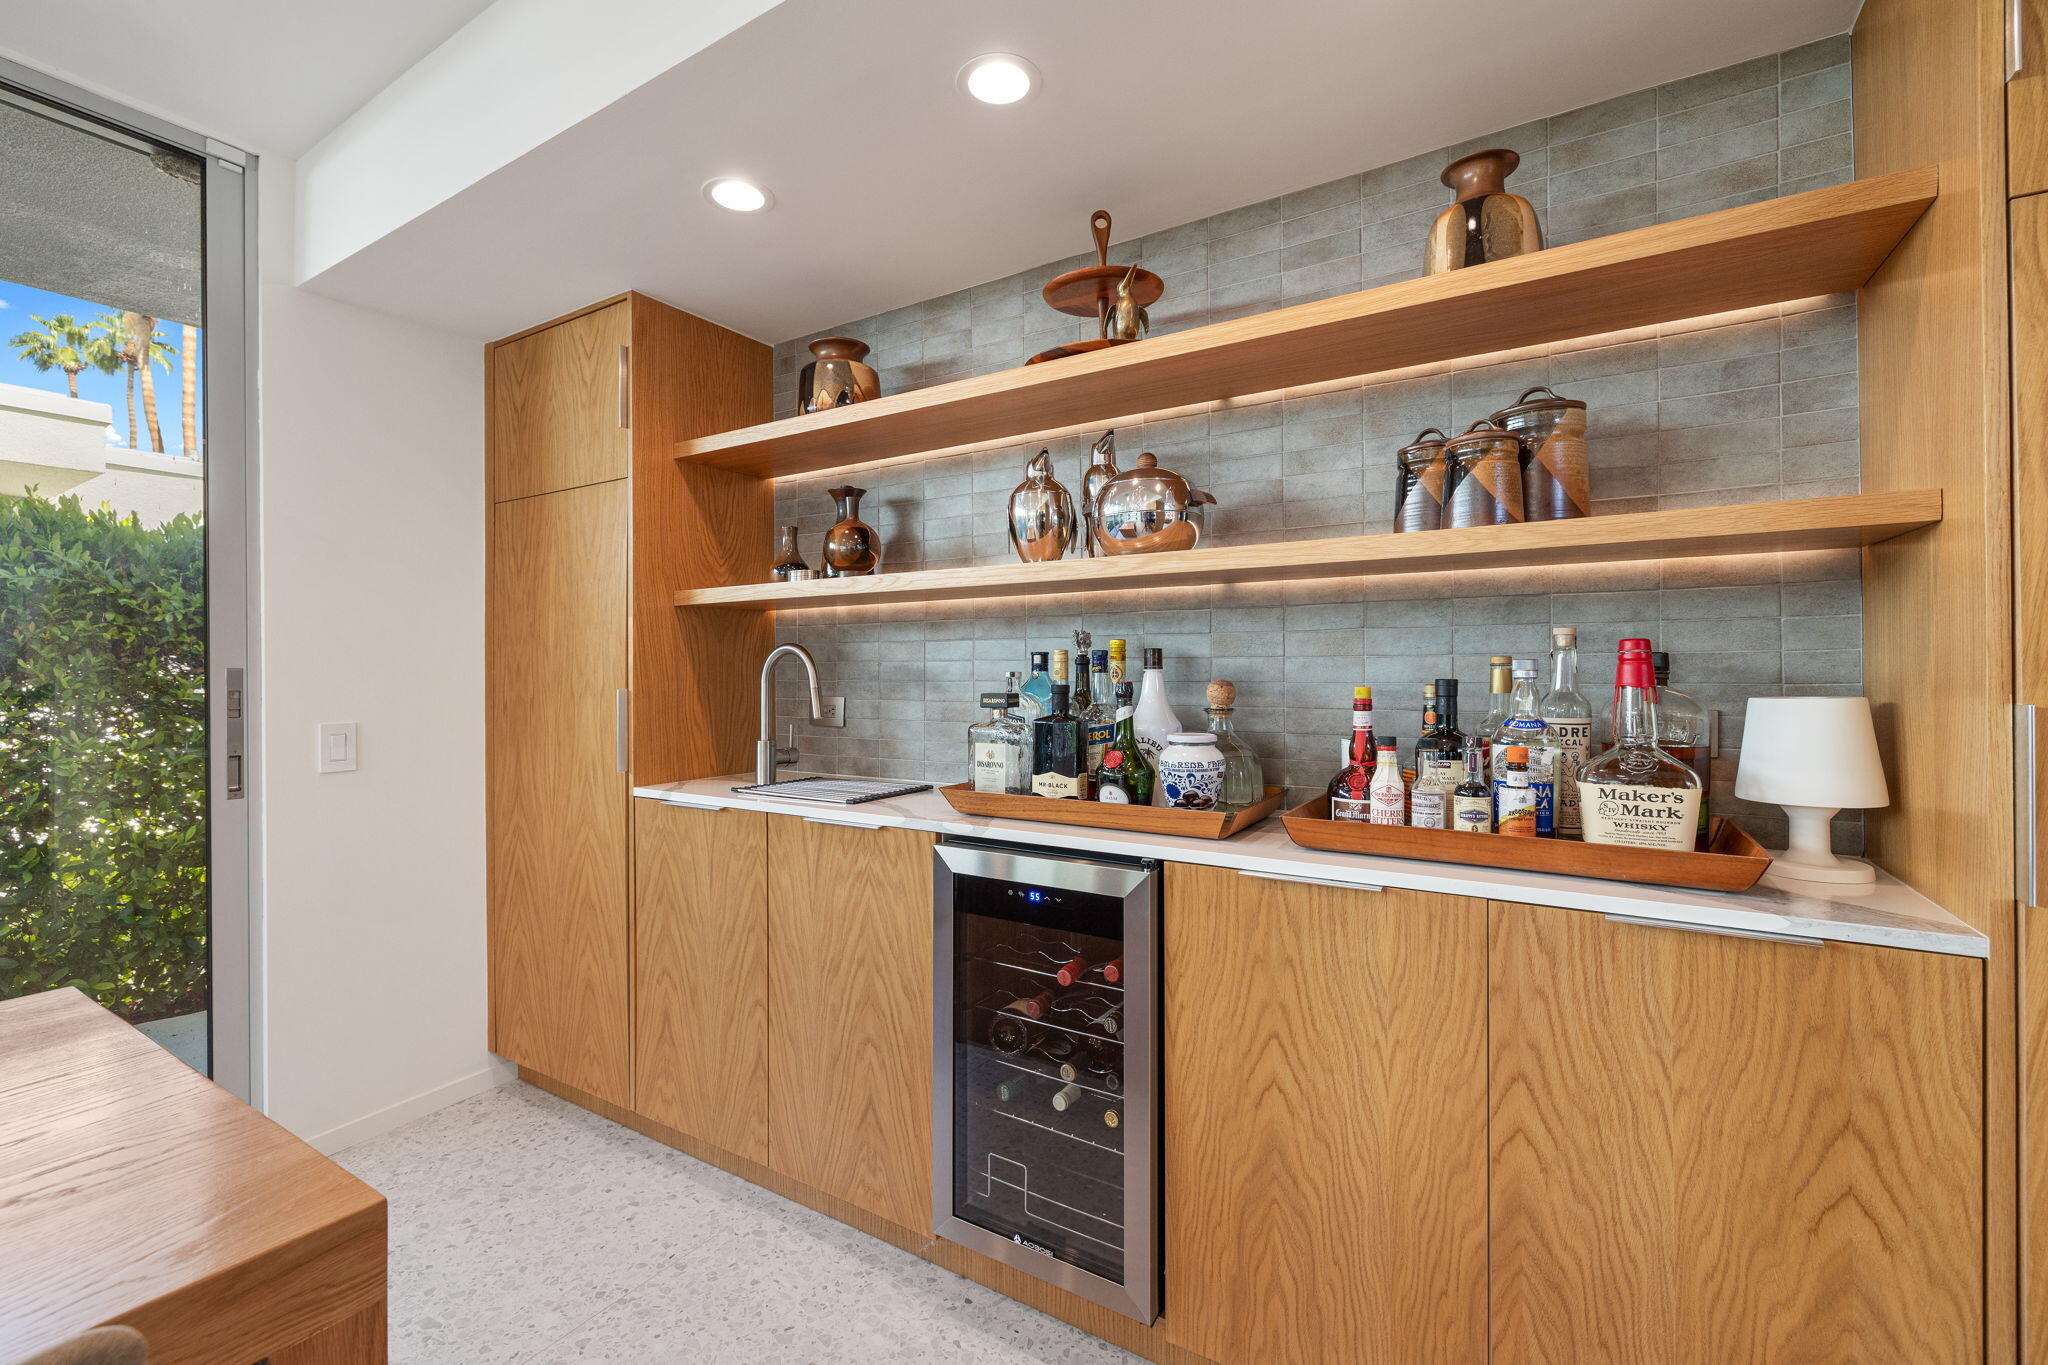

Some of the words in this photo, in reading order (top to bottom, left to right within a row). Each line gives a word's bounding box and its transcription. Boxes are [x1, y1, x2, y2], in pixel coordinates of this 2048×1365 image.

[1087, 729, 1111, 742] EROL
[1560, 727, 1589, 738] DRE
[1135, 736, 1163, 752] ALIBU
[976, 760, 1004, 769] DISARONNO
[1597, 787, 1684, 804] Maker's
[1371, 808, 1405, 818] CHERRY
[1620, 803, 1684, 820] Mark
[1613, 821, 1670, 832] WHISKY
[1030, 892, 1040, 901] 55
